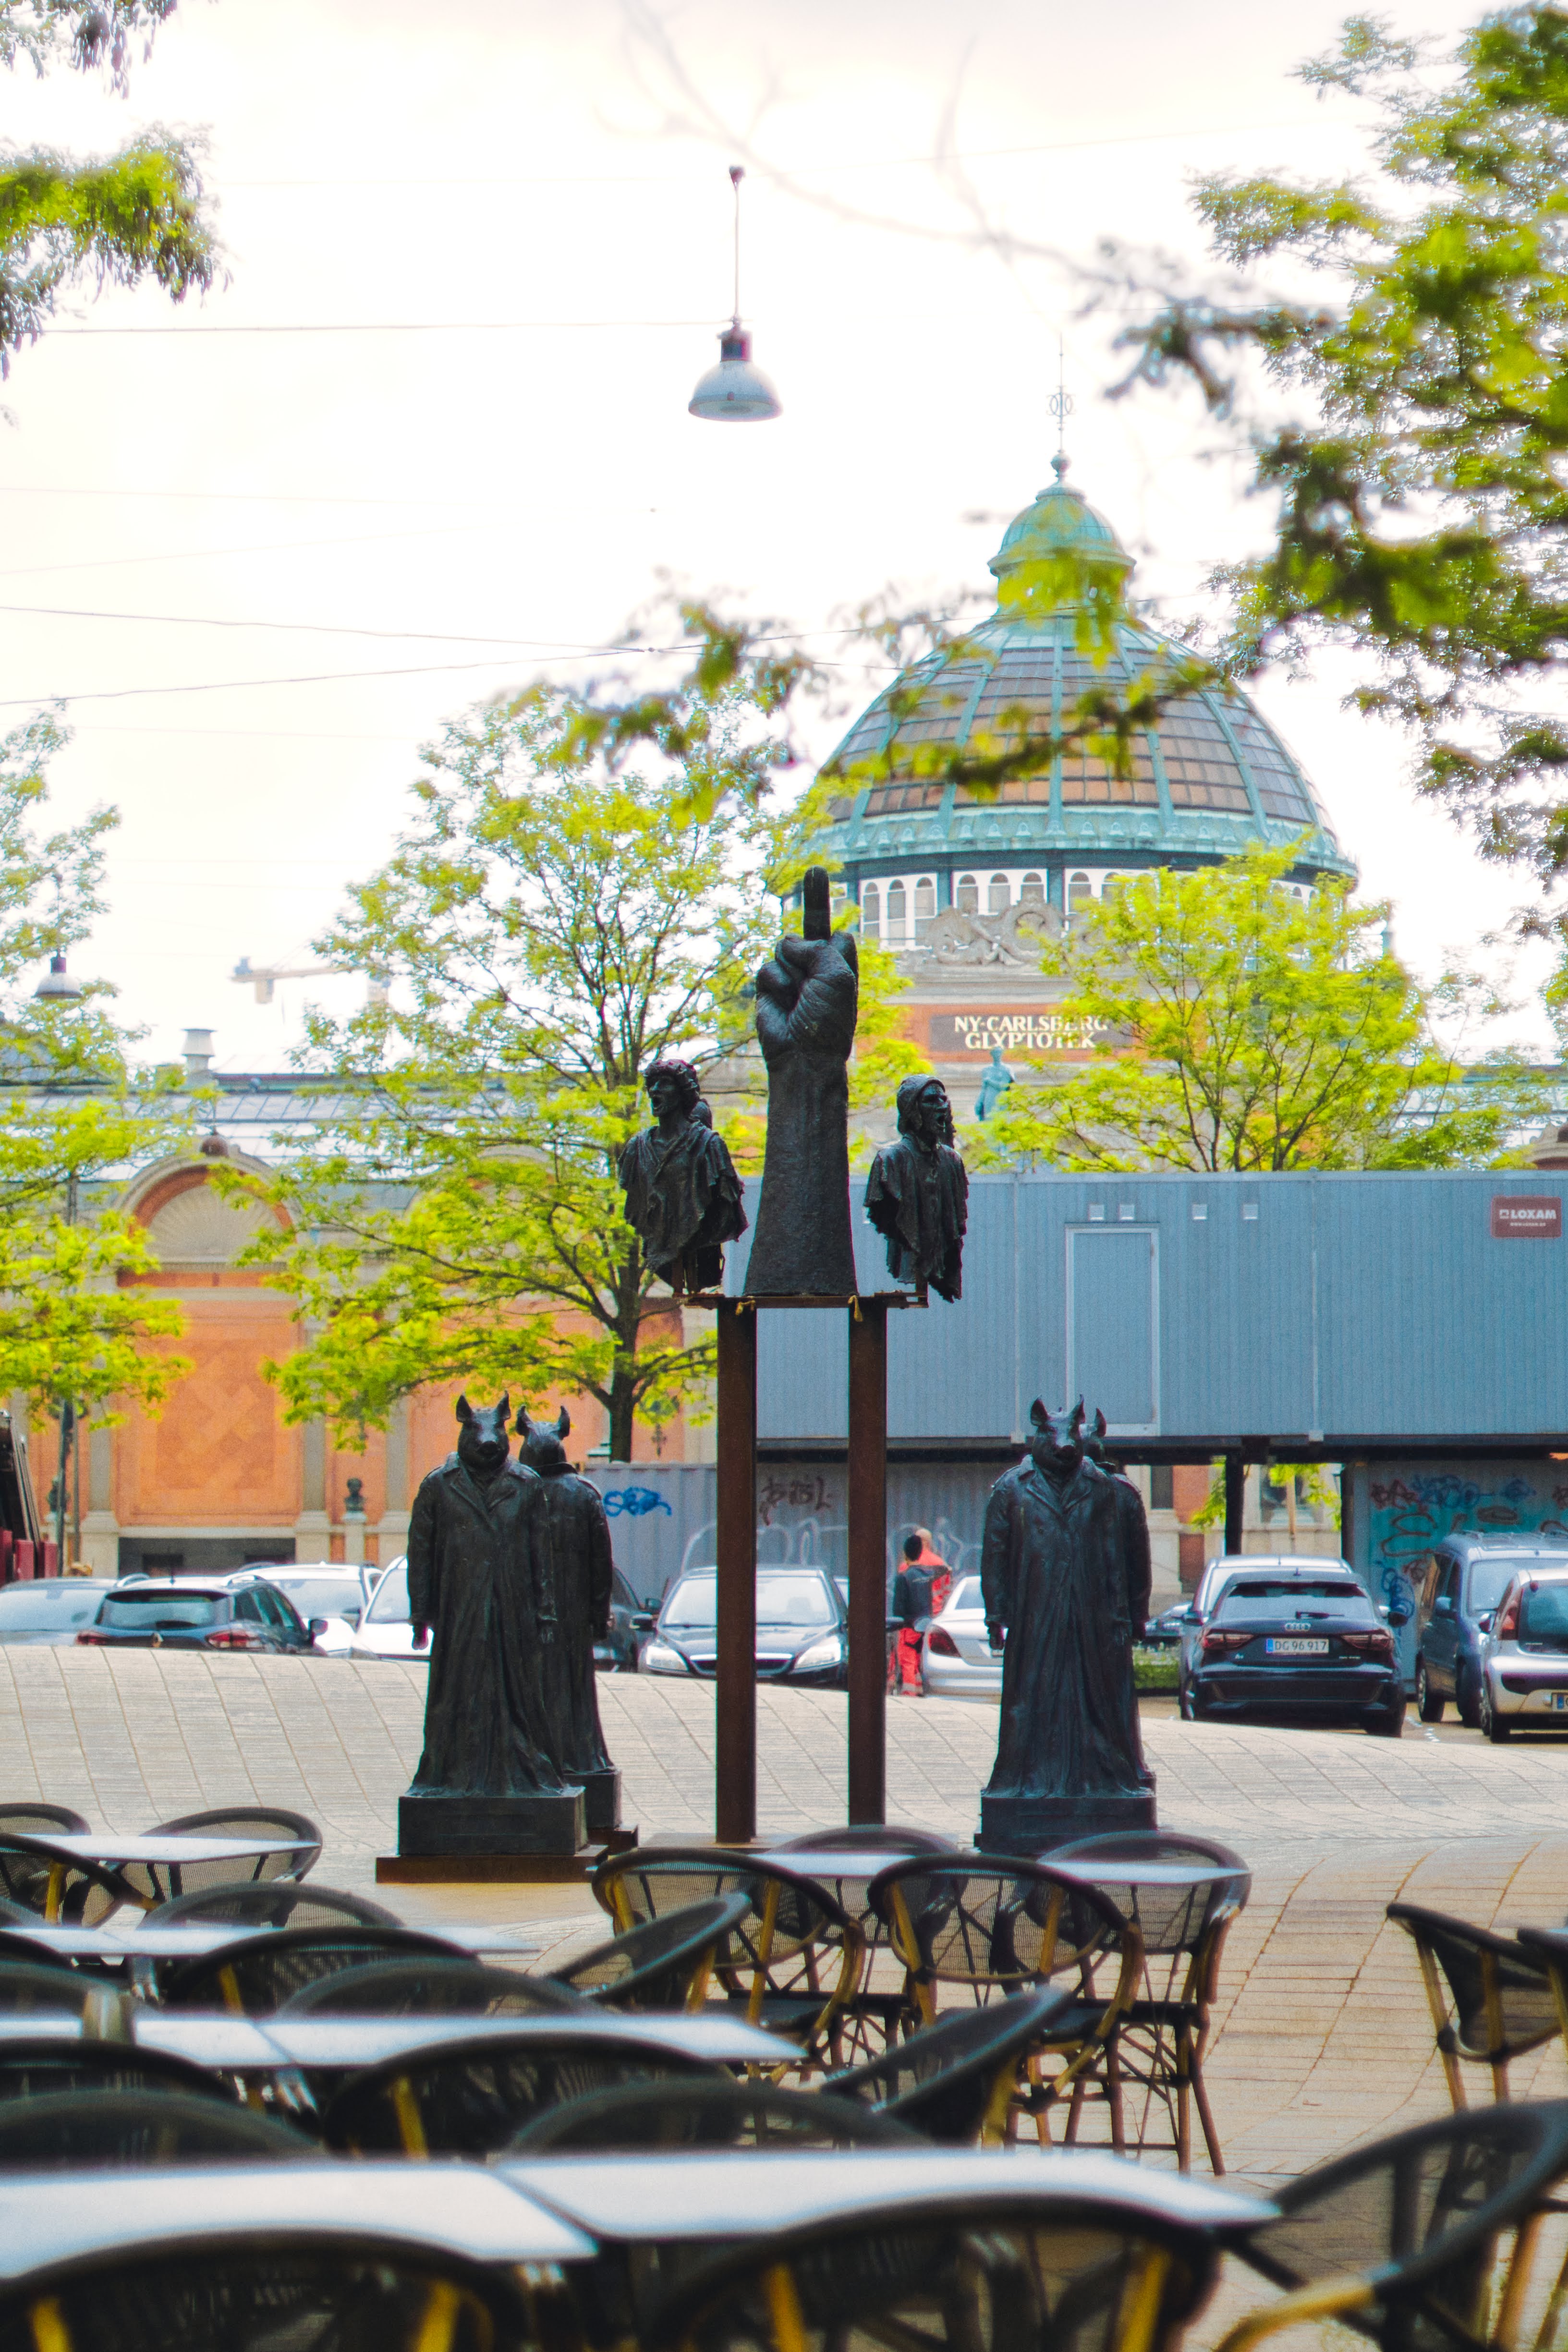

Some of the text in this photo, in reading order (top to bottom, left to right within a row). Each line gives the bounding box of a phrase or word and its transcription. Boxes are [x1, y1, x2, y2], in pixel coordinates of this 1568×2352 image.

[1510, 1209, 1556, 1220] LOXAM
[1291, 1640, 1305, 1651] 96
[1307, 1640, 1327, 1651] 917
